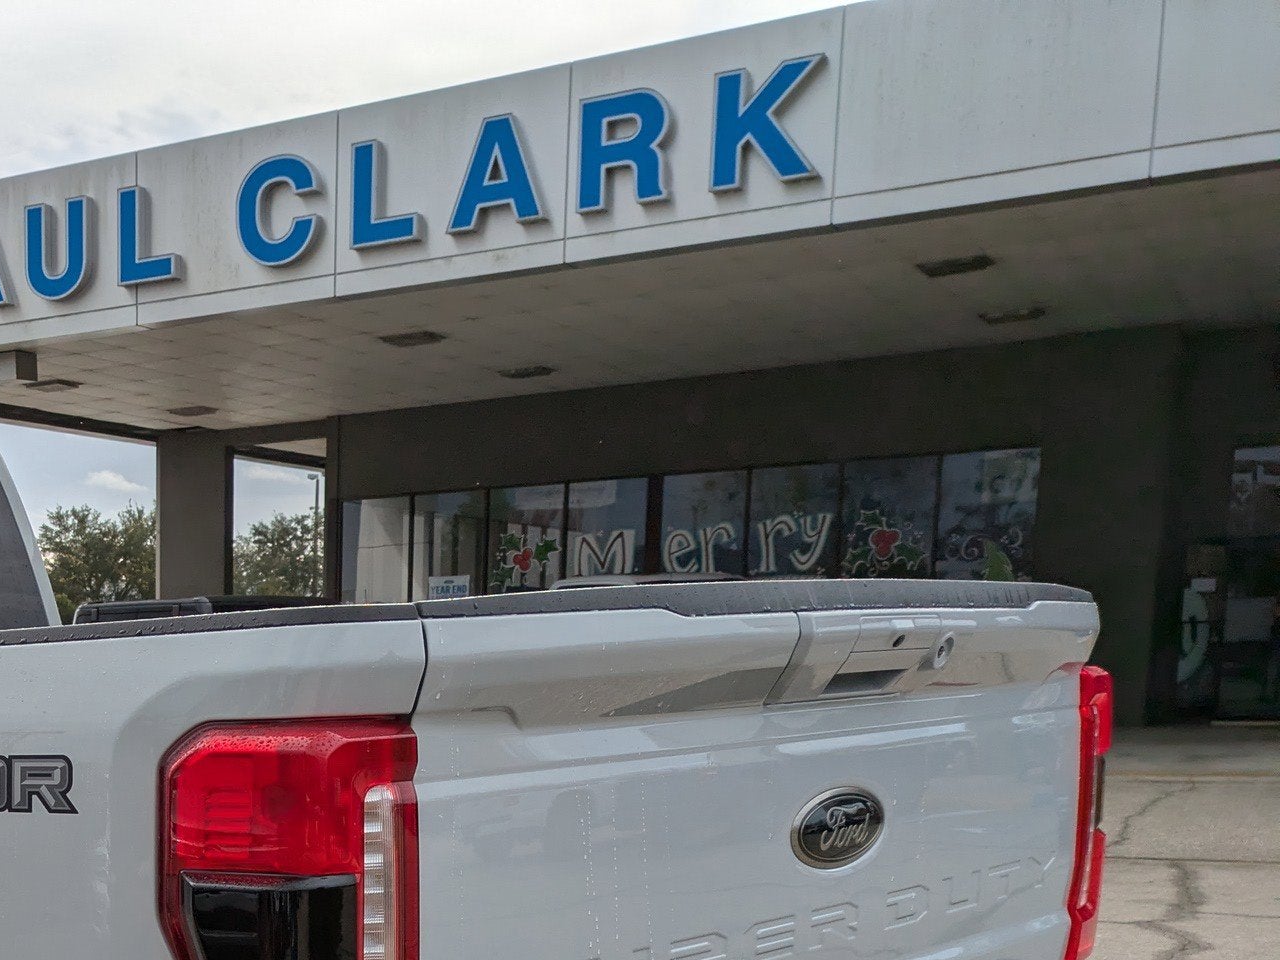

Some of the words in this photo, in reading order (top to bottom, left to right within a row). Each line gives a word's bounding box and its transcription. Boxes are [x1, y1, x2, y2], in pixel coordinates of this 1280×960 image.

[236, 52, 827, 268] CLARK
[568, 513, 833, 576] Merry
[431, 585, 451, 595] YEAR
[452, 584, 468, 594] END
[820, 802, 872, 851] Ford
[883, 857, 1057, 931] DUTY
